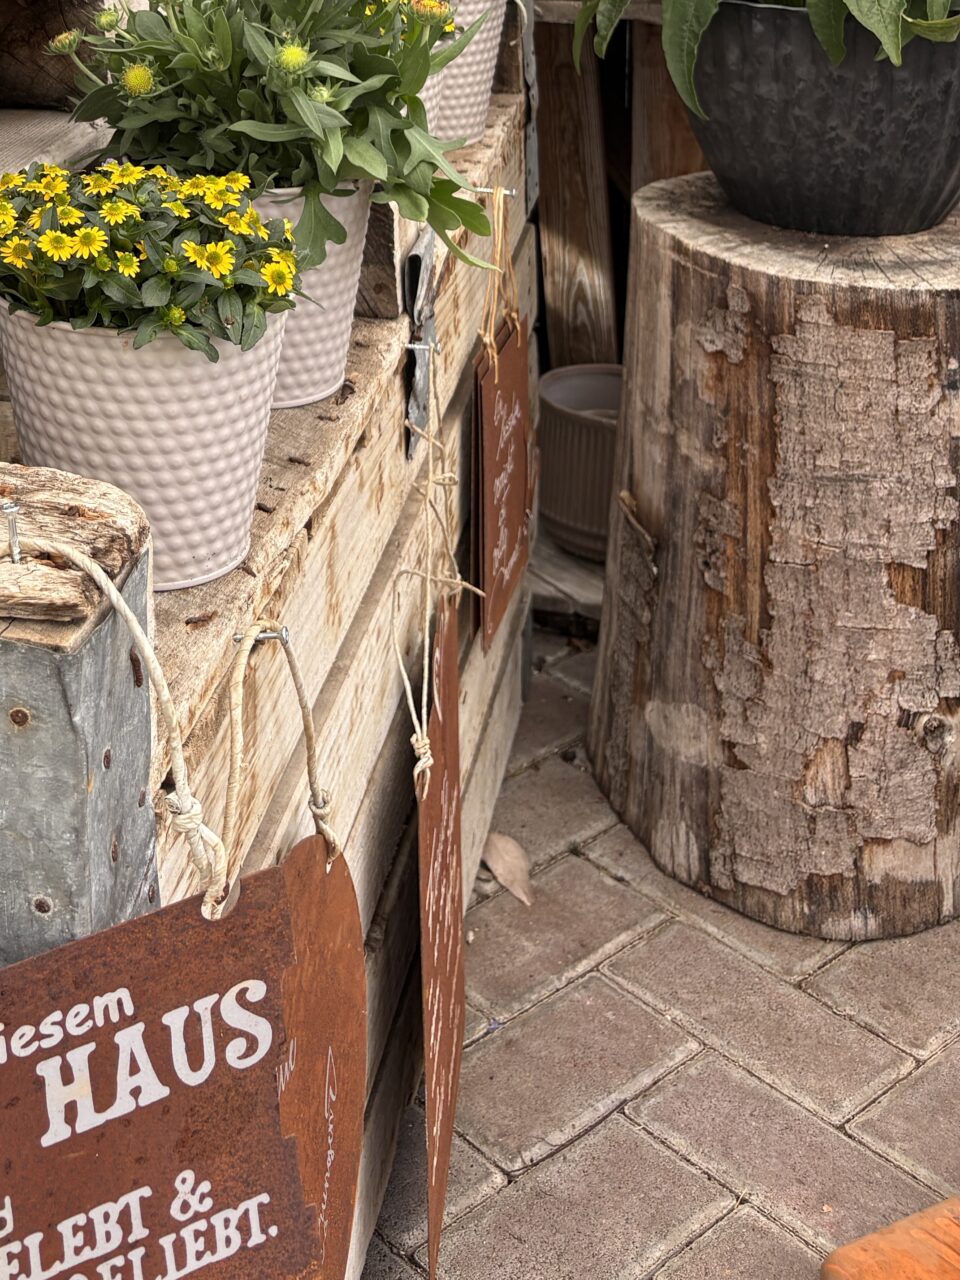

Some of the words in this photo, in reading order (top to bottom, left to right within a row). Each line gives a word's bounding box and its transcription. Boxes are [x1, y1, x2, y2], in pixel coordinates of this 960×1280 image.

[35, 980, 273, 1147] HAUS
[73, 1193, 278, 1280] ELIEBT.
[170, 1169, 213, 1221] &
